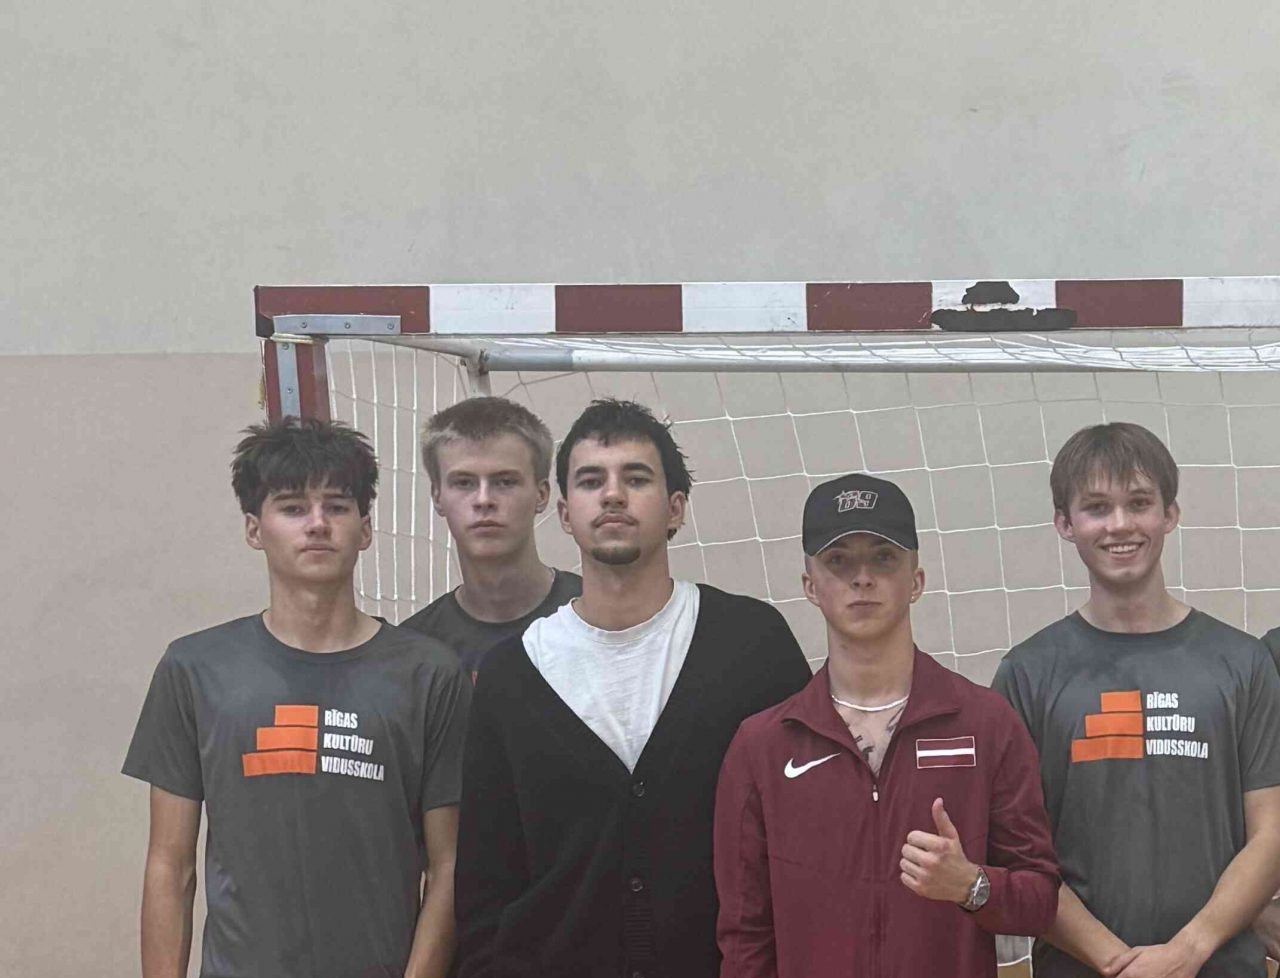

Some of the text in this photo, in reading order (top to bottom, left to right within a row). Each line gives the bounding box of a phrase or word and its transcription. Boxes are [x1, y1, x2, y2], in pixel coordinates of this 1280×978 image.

[1146, 691, 1179, 709] RĪGAS
[324, 708, 358, 729] RĪGAS
[1146, 714, 1196, 733] KULTŪRU
[323, 733, 374, 755] KULTŪRU
[1146, 739, 1209, 759] VIDUSSKOLA
[321, 756, 385, 782] VIDUSSKOLA
